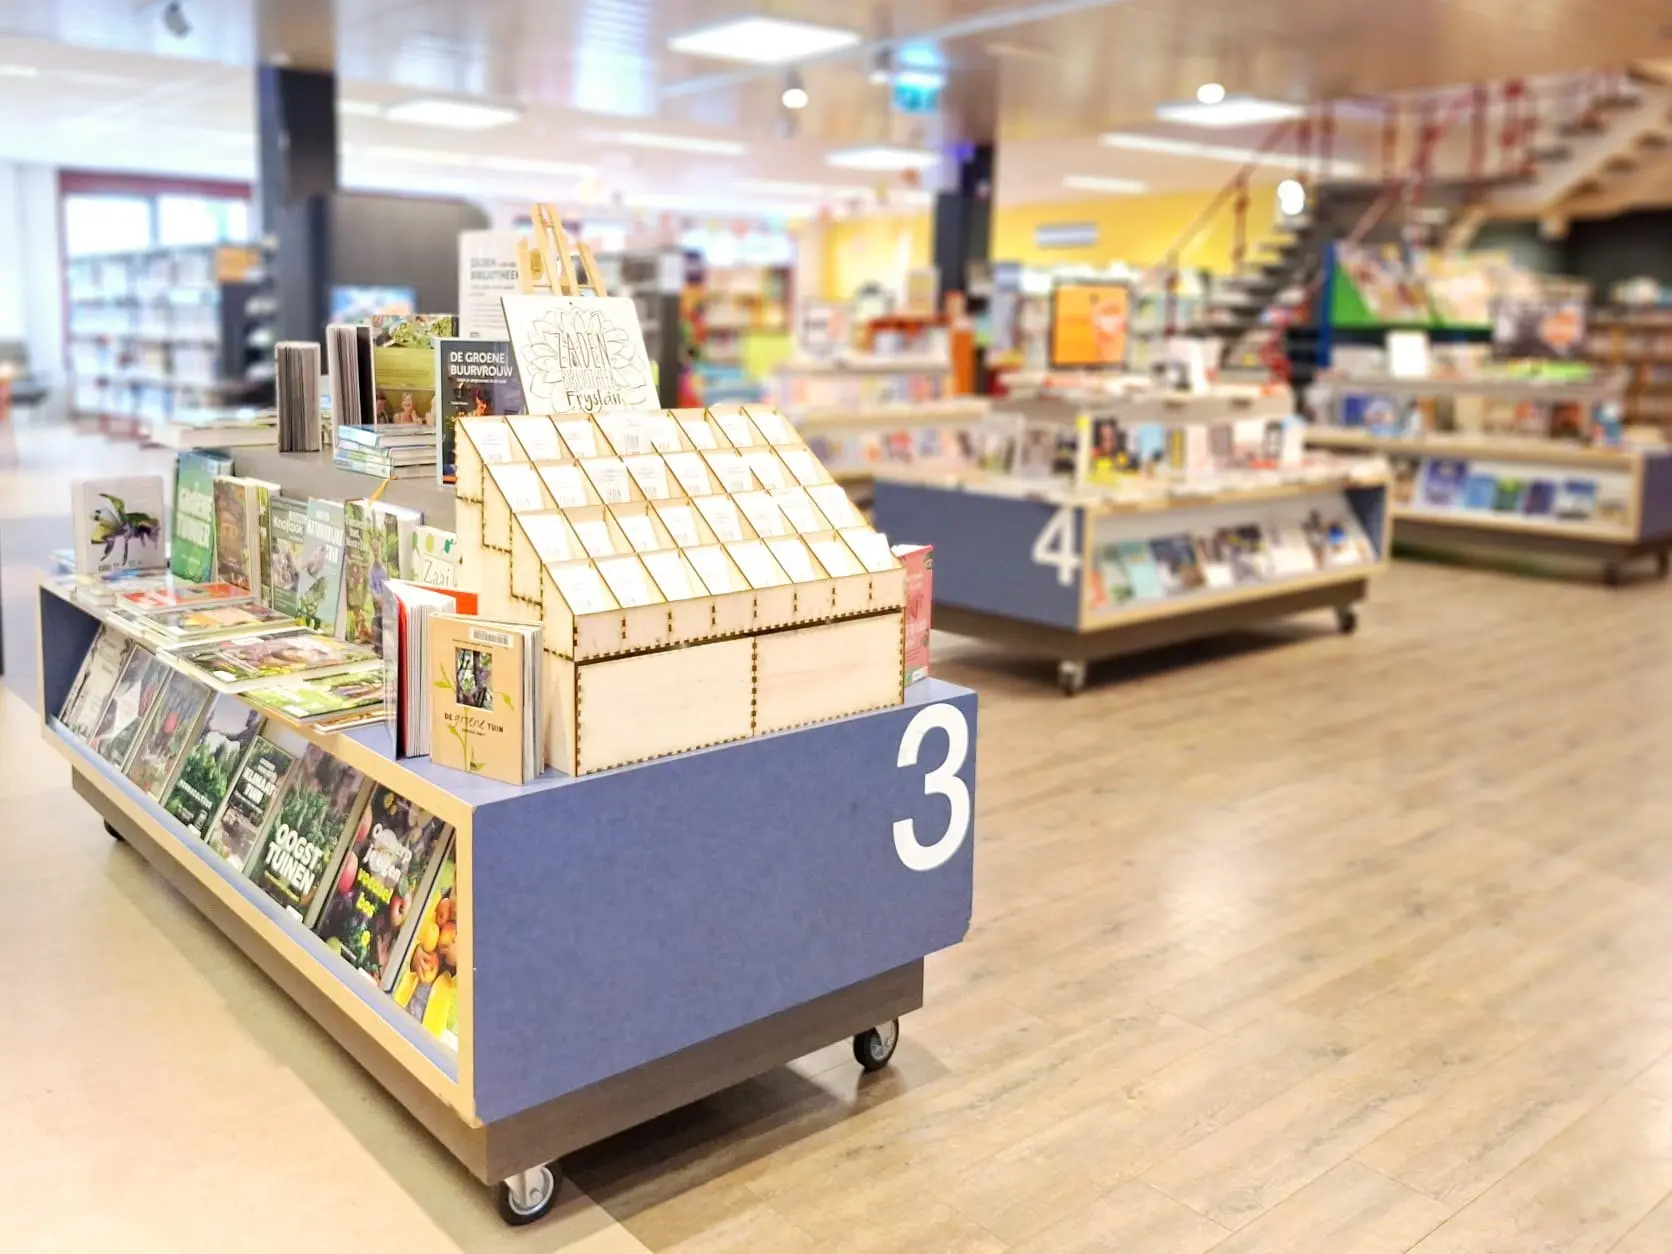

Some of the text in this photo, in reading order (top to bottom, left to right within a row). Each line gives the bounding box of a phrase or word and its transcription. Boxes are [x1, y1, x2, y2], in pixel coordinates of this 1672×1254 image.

[450, 352, 505, 363] DE GROENE
[553, 333, 613, 368] ZADEN
[451, 364, 512, 376] BUURVROUW
[1030, 507, 1083, 586] 4
[444, 712, 453, 721] DE
[487, 722, 504, 733] TUIN
[892, 702, 971, 872] 3
[274, 824, 324, 872] OOGST
[265, 841, 316, 896] TUINEN
[356, 891, 377, 919] bos
